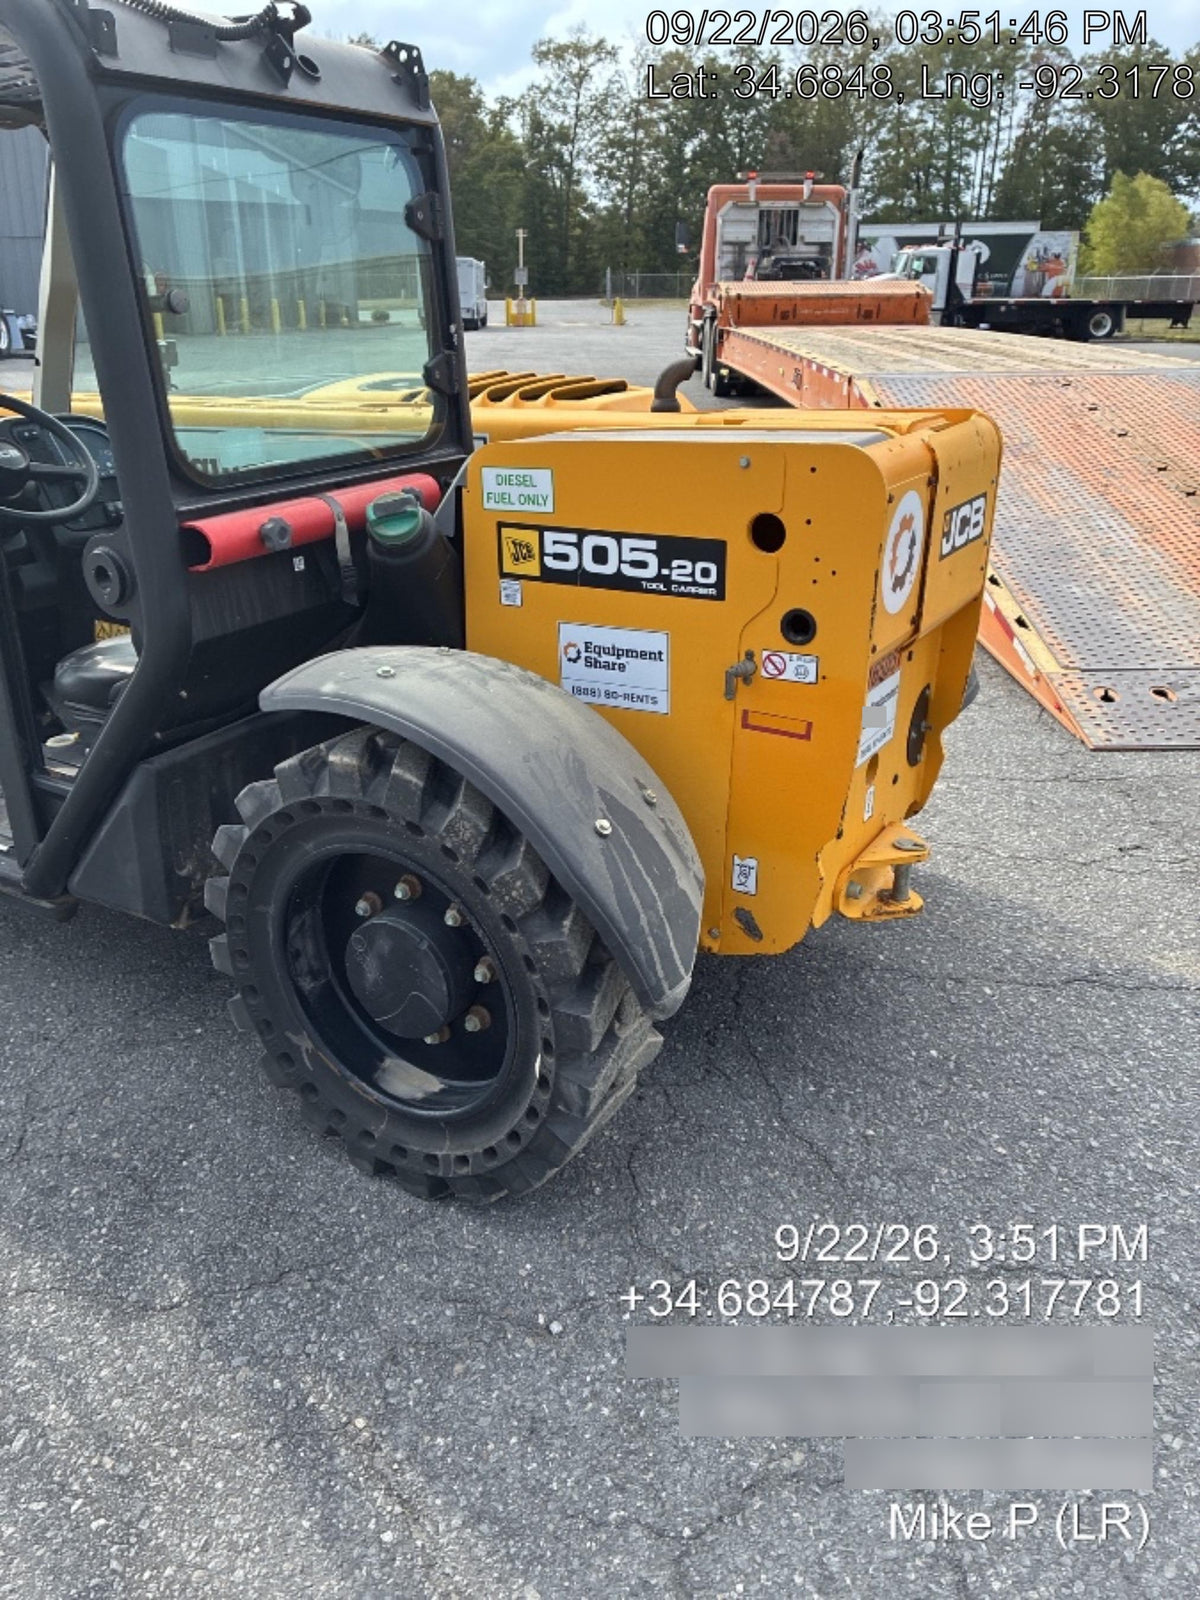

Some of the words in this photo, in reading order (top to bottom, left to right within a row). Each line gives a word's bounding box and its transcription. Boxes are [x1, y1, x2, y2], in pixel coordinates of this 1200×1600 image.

[495, 473, 538, 488] DIESEL
[486, 491, 516, 506] FUEL
[518, 493, 549, 508] ONLY
[941, 496, 986, 556] JCB
[543, 530, 718, 585] 505-20
[583, 641, 664, 662] Equipment
[584, 656, 627, 673] Share
